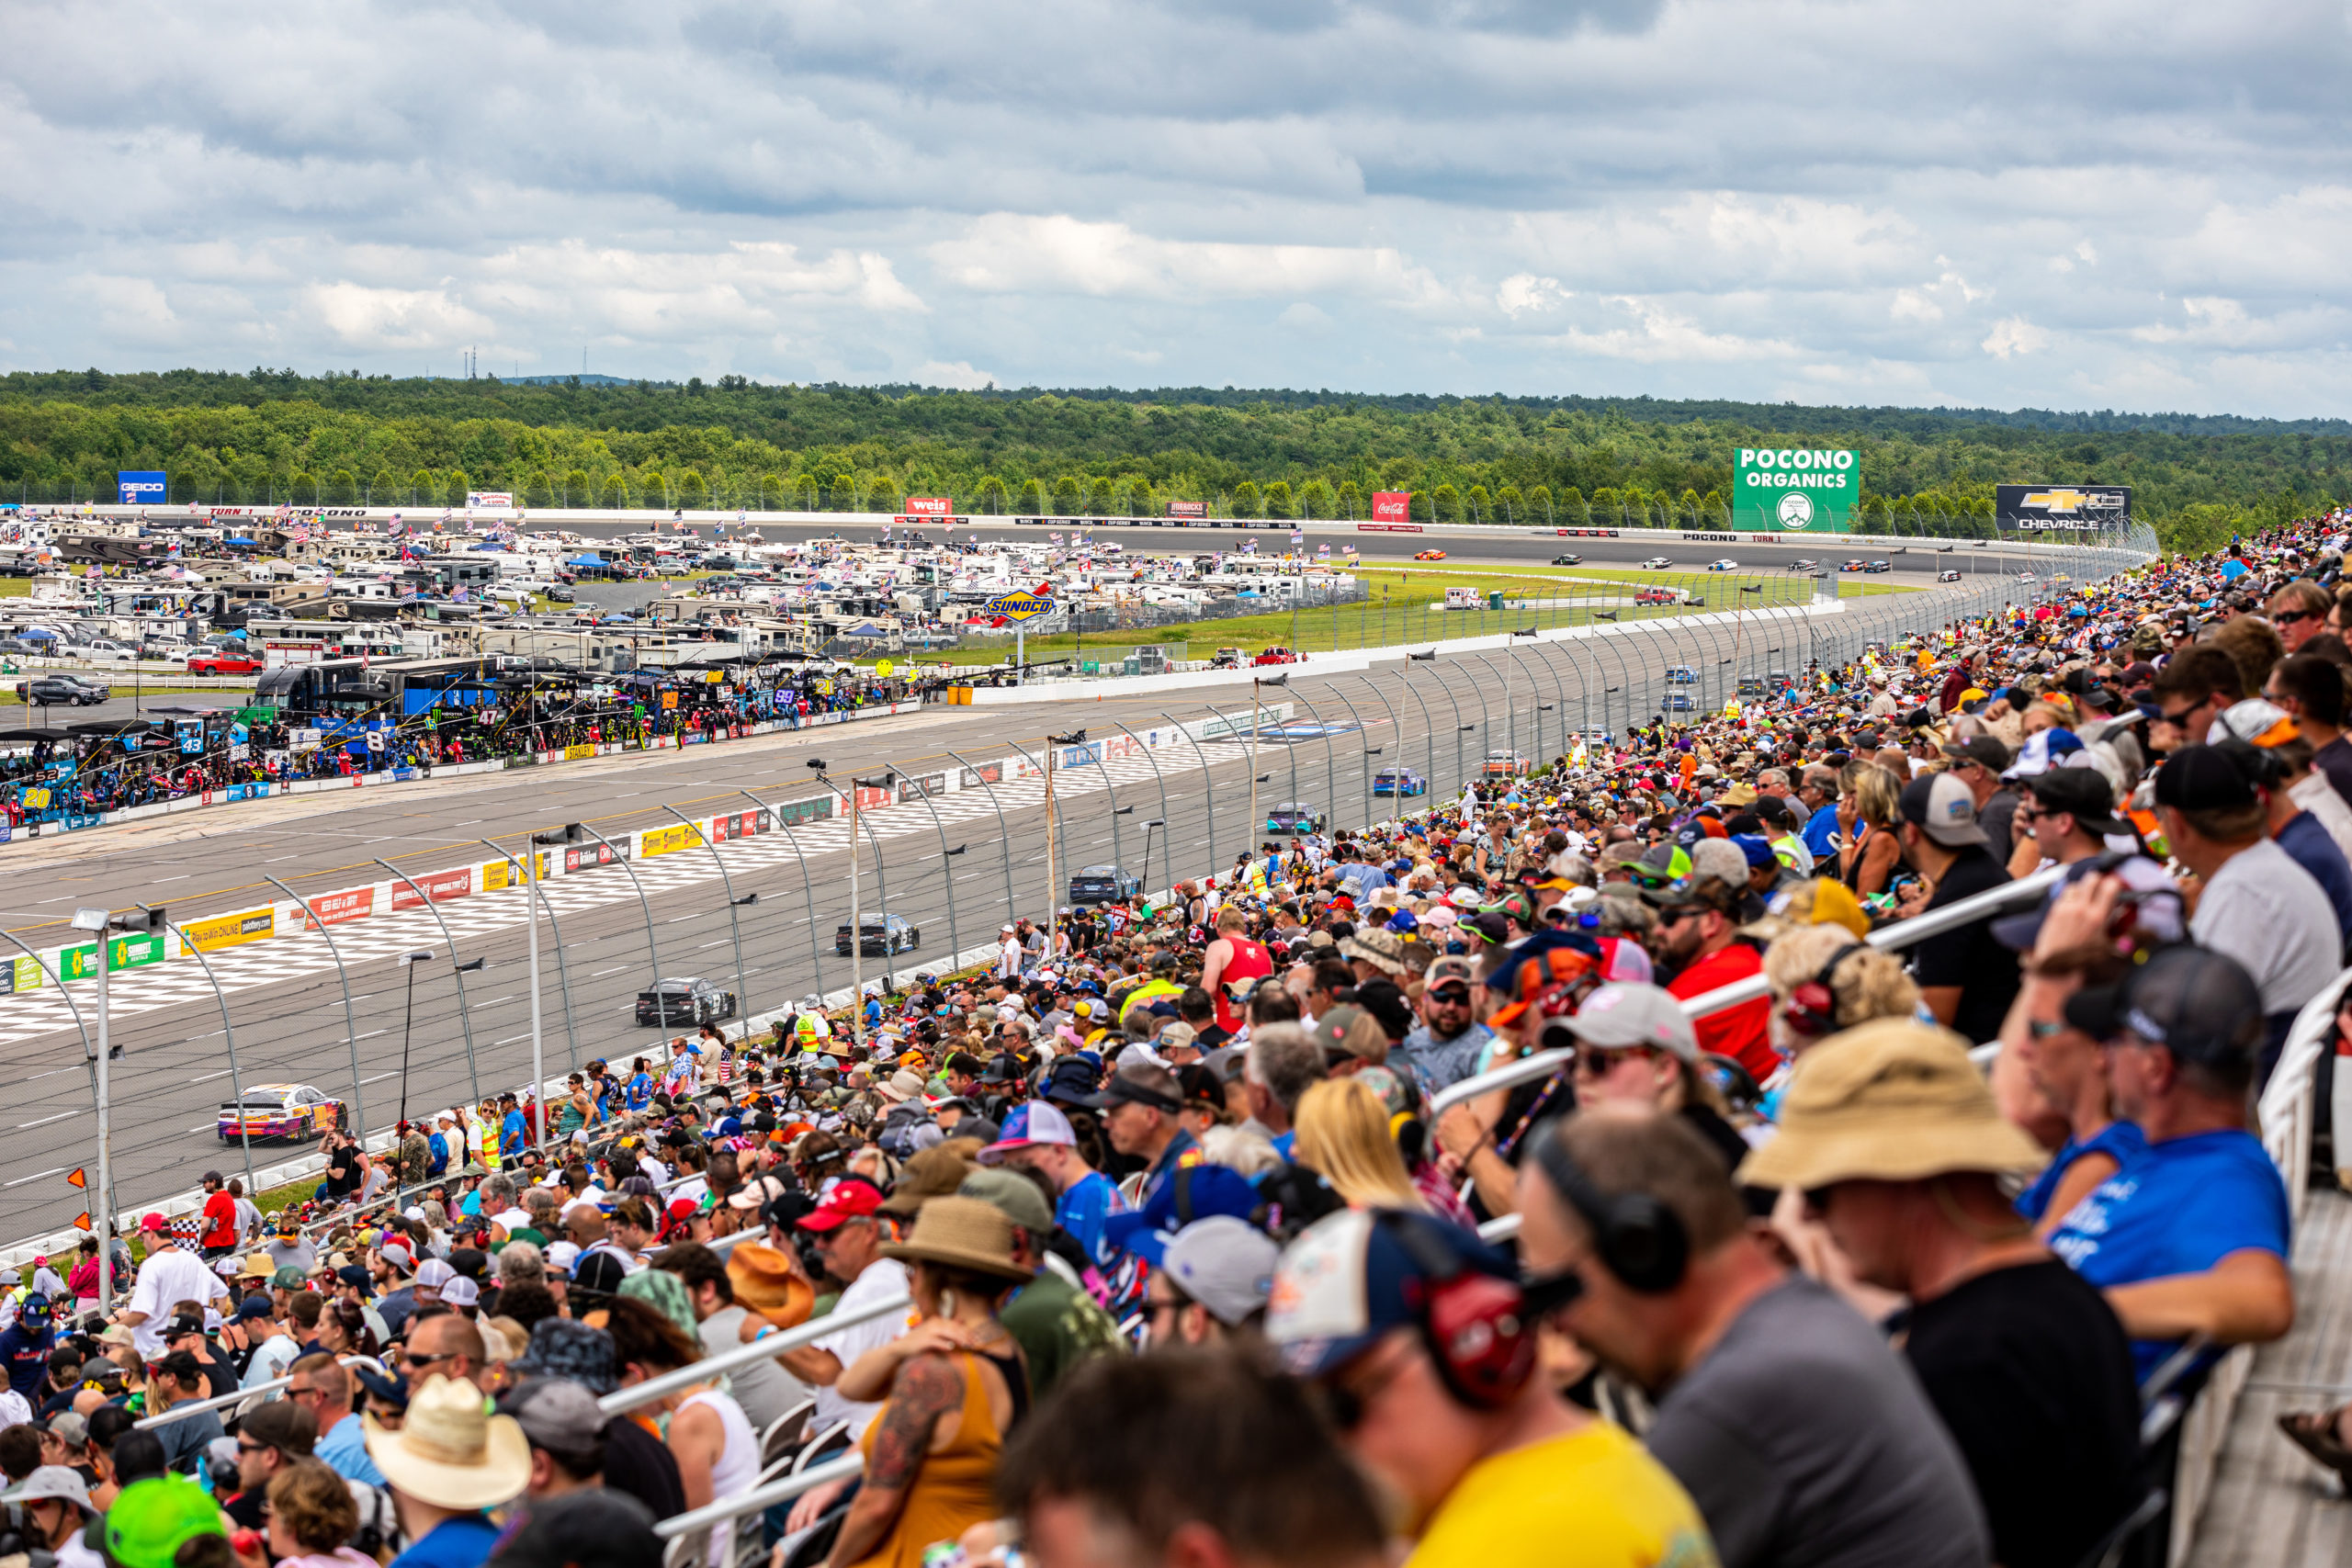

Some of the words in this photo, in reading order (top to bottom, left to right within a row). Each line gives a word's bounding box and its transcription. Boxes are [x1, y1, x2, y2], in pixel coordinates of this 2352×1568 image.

[1741, 449, 1853, 469] POCONO
[1746, 472, 1847, 488] ORGANICS
[120, 483, 164, 491] GEICO
[912, 499, 946, 511] weis
[1378, 502, 1405, 514] Coca-Cola
[2018, 519, 2105, 530] CHEVROLE
[989, 601, 1050, 612] SUNOCO
[905, 670, 919, 682] 5
[816, 680, 833, 694] 21
[662, 692, 679, 709] 19
[775, 690, 795, 704] 99
[479, 710, 498, 725] 47
[424, 718, 436, 730] 15
[183, 739, 201, 751] 43
[366, 731, 385, 752] 8
[569, 745, 591, 759] STANLEY
[35, 770, 57, 781] 52
[246, 786, 252, 797] 8
[23, 787, 51, 809] 20
[434, 882, 452, 893] GENERAL
[242, 918, 271, 933] palottery.com
[192, 932, 202, 944] Play
[208, 930, 218, 940] Win
[219, 924, 240, 938] ONLINE!
[130, 953, 149, 962] RENTALS
